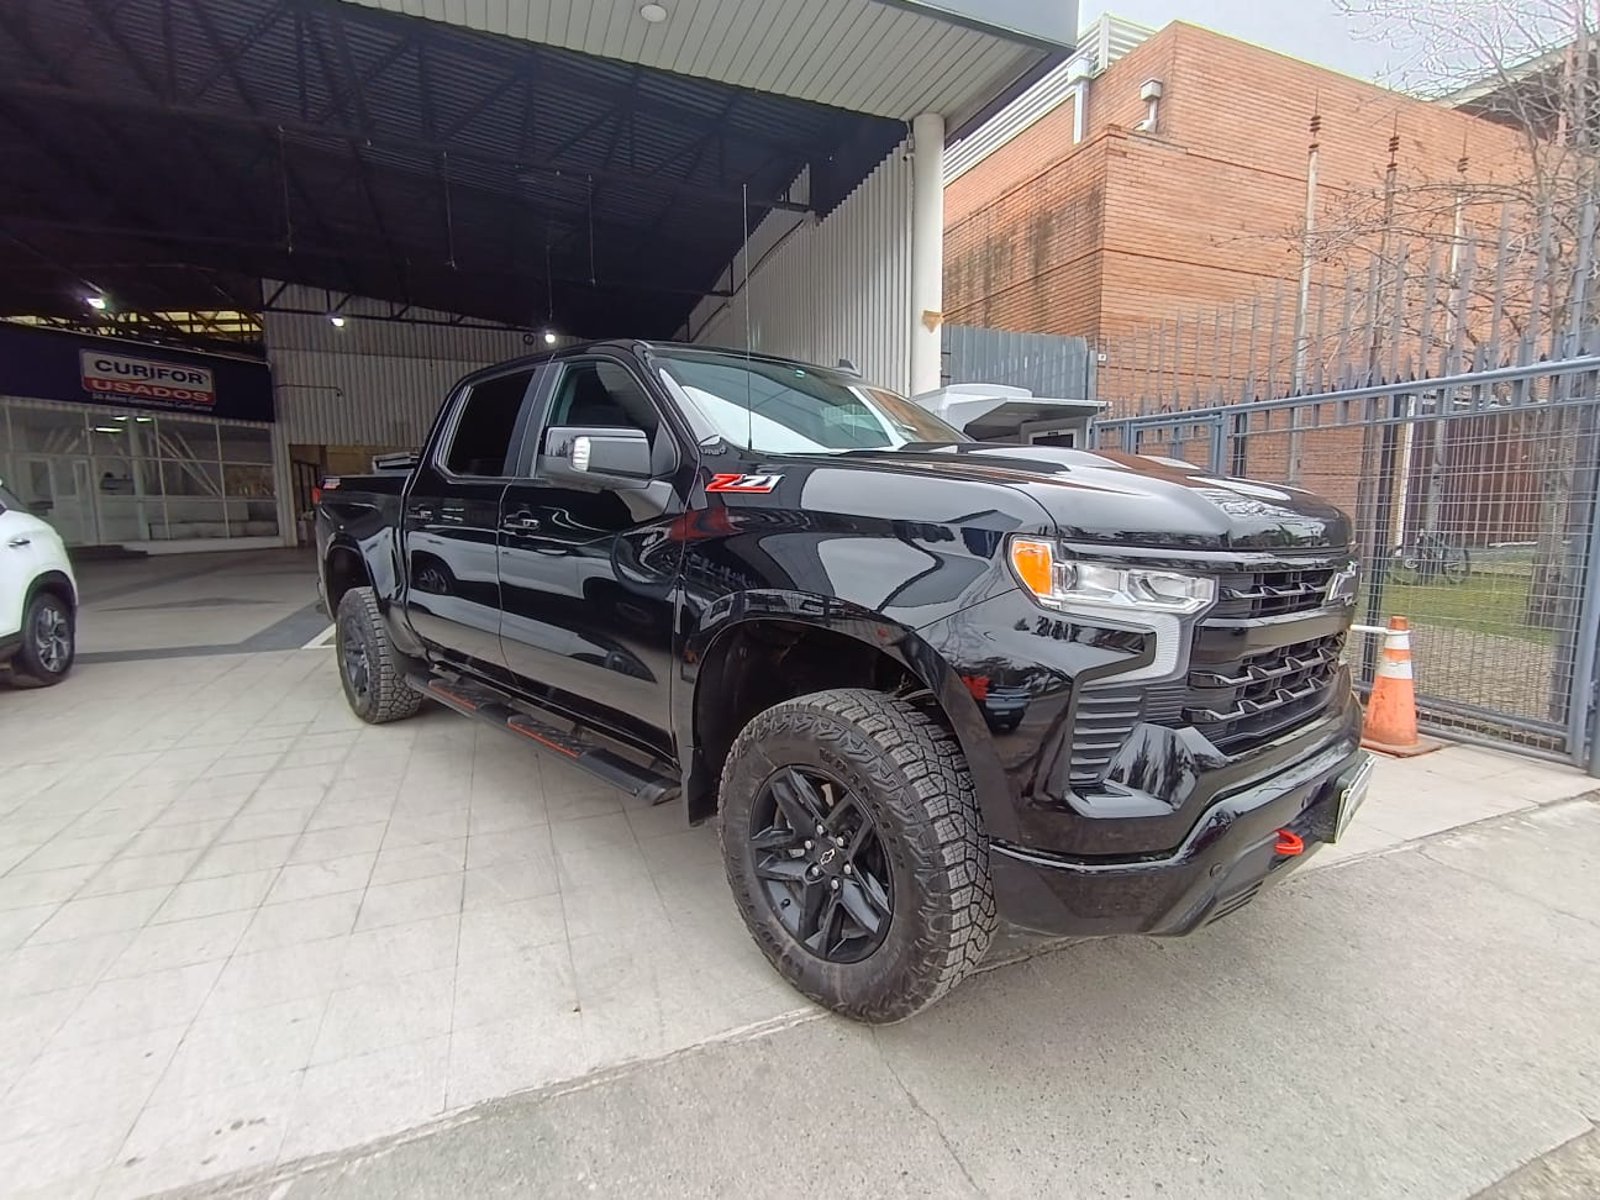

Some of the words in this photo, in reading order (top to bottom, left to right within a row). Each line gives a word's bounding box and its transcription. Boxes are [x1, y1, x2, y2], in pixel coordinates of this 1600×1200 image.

[94, 359, 203, 384] CURIFOR
[92, 379, 209, 401] USADOS
[704, 473, 785, 494] Z71
